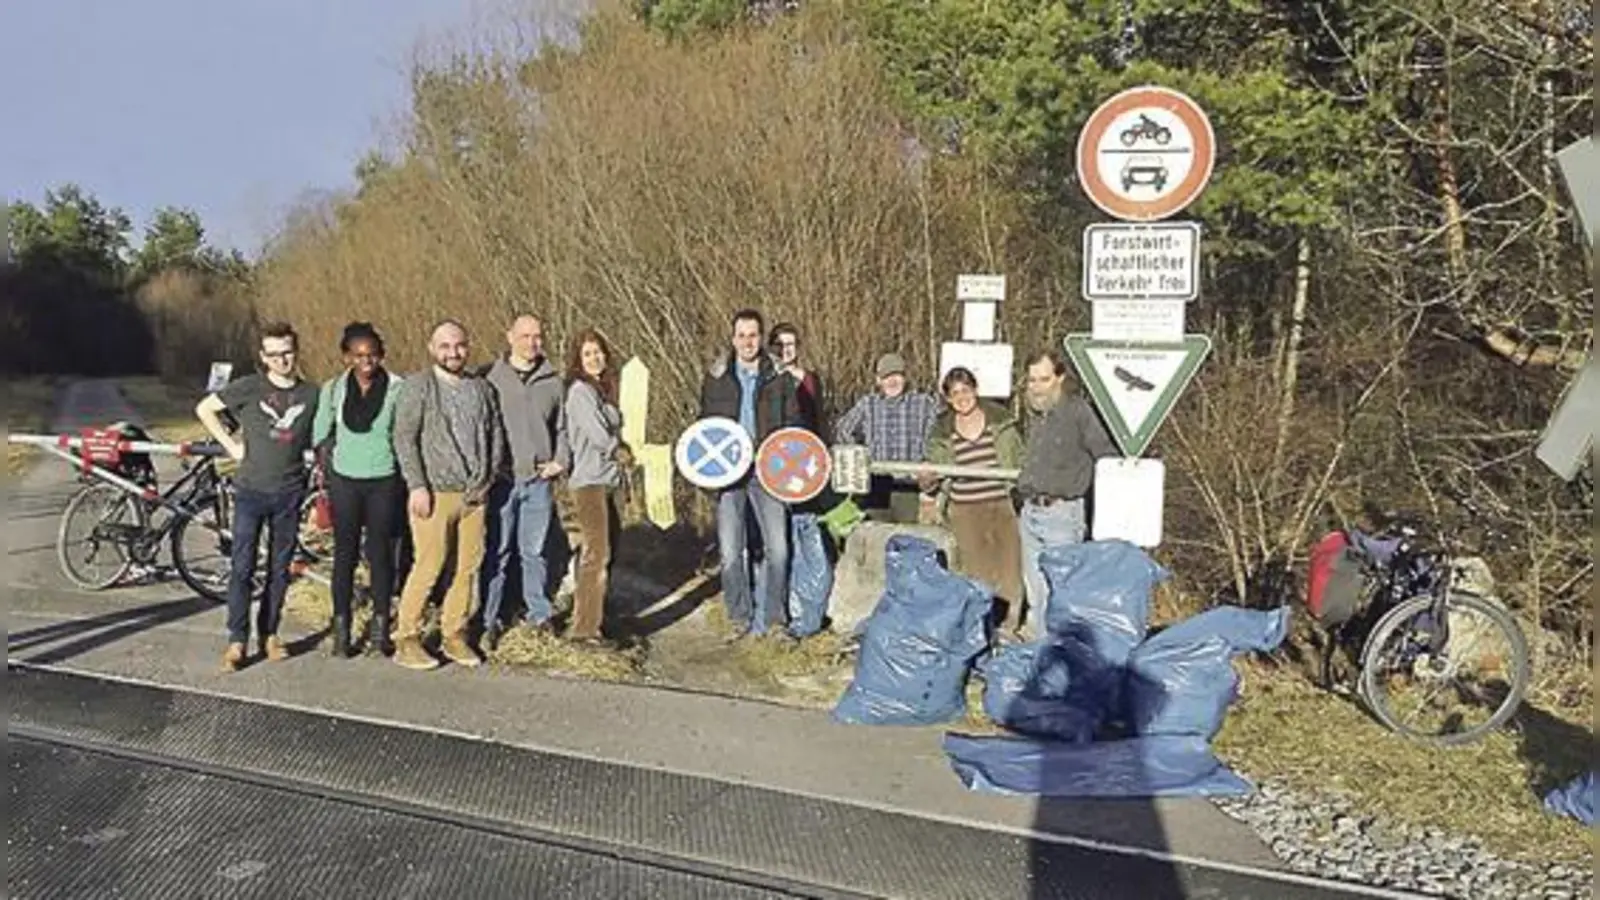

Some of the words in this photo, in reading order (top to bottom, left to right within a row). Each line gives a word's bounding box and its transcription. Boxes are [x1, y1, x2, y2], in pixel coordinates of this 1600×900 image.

[1102, 233, 1181, 250] Forstwirt-
[1096, 253, 1185, 272] schaftlicher
[1094, 273, 1153, 292] Verkehr
[1158, 274, 1187, 291] frei
